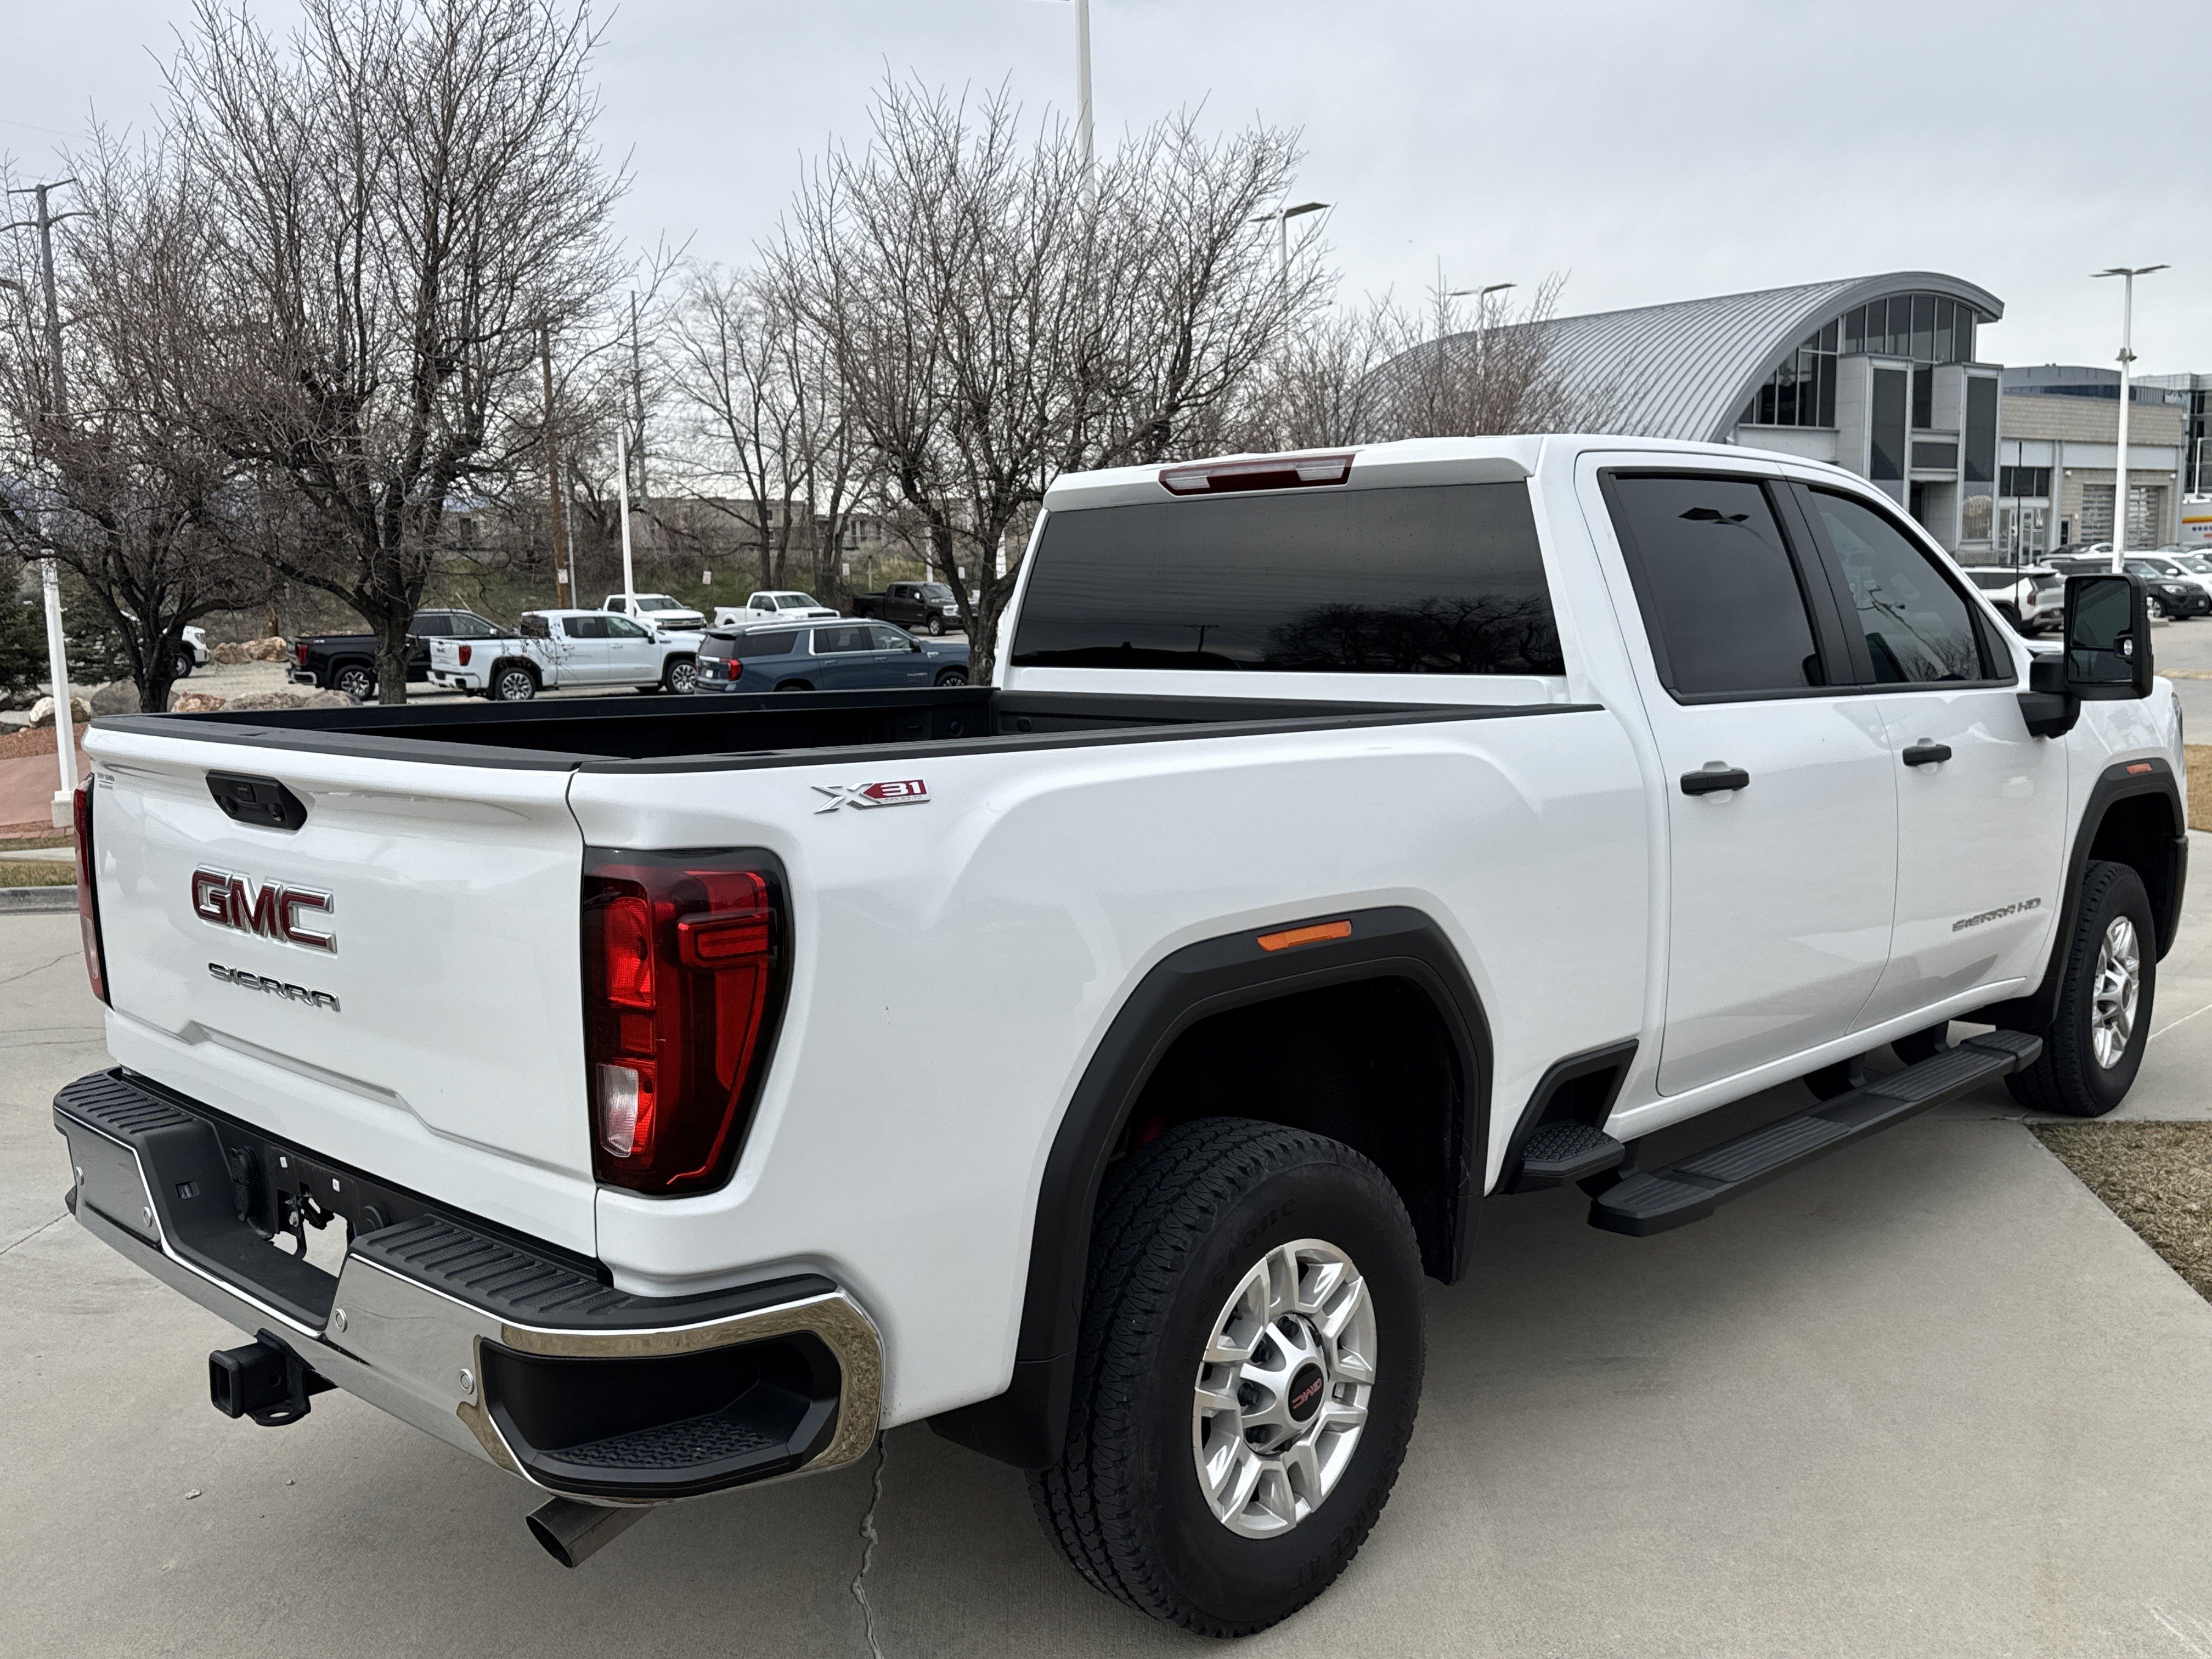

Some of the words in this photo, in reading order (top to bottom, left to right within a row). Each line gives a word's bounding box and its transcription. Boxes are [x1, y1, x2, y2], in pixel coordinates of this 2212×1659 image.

[192, 865, 338, 955] GMC
[1952, 904, 2016, 932] SIERRA
[2017, 897, 2041, 913] HD
[208, 962, 341, 1012] SIERRA
[1291, 1377, 1322, 1409] GMC
